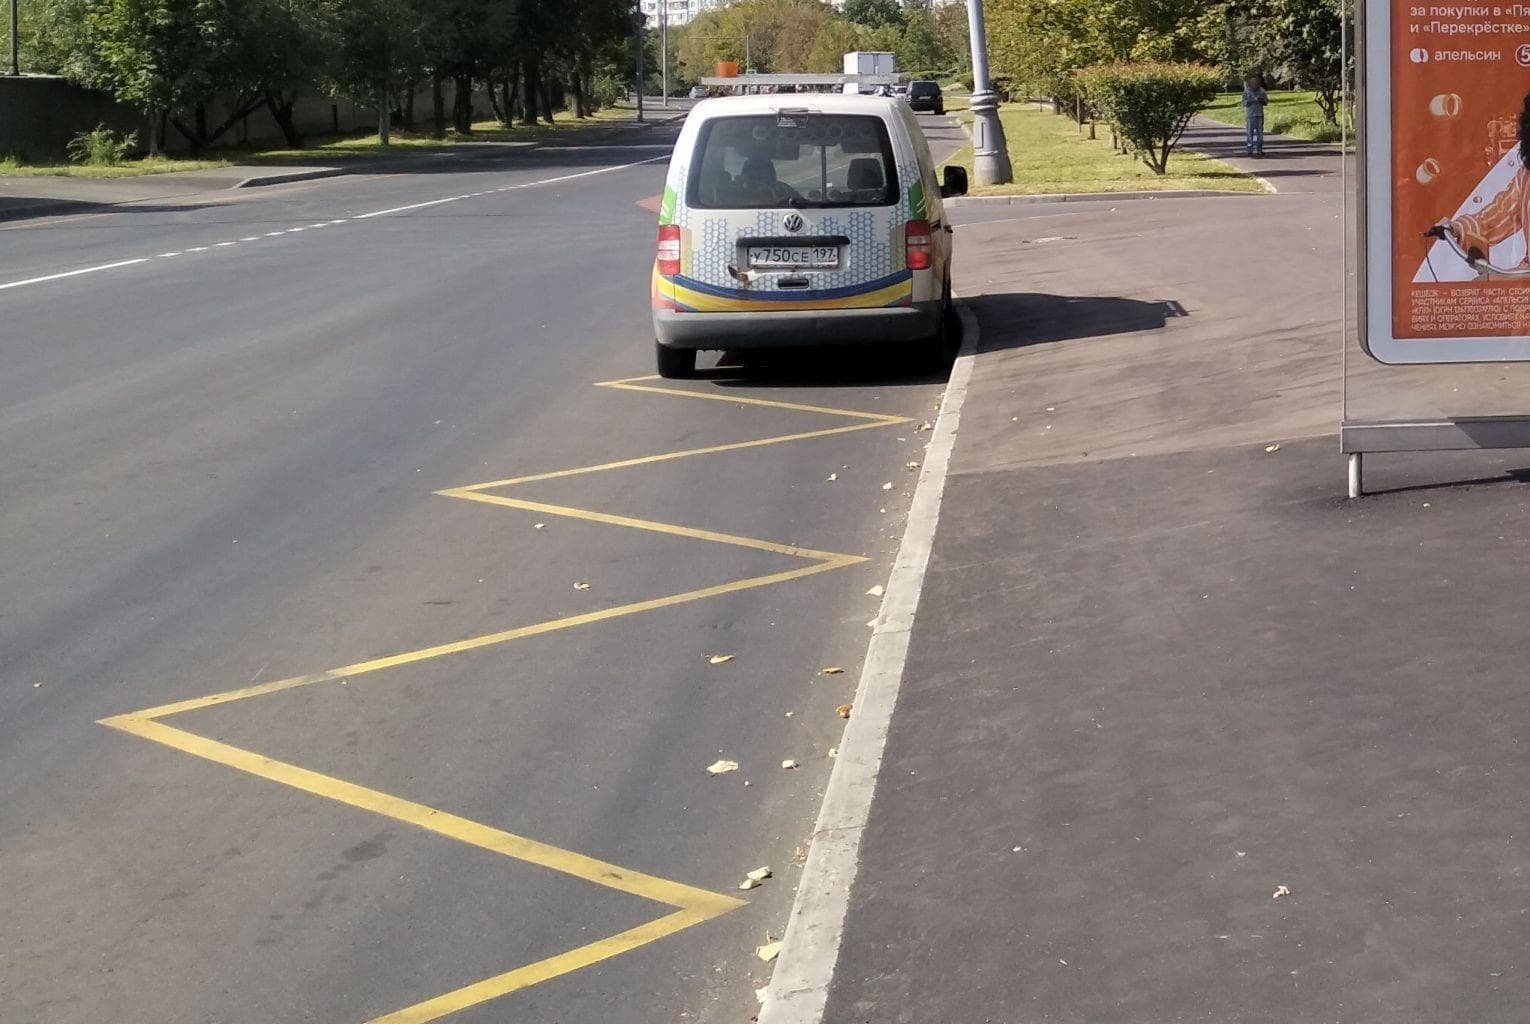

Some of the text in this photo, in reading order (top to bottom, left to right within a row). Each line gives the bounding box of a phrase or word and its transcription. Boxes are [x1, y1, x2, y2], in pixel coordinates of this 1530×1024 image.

[1410, 6, 1427, 18] за
[1430, 5, 1490, 21] покупки
[1493, 6, 1502, 18] в
[1410, 21, 1530, 36] и «Перекрёстке»
[1434, 48, 1502, 62] апельсин
